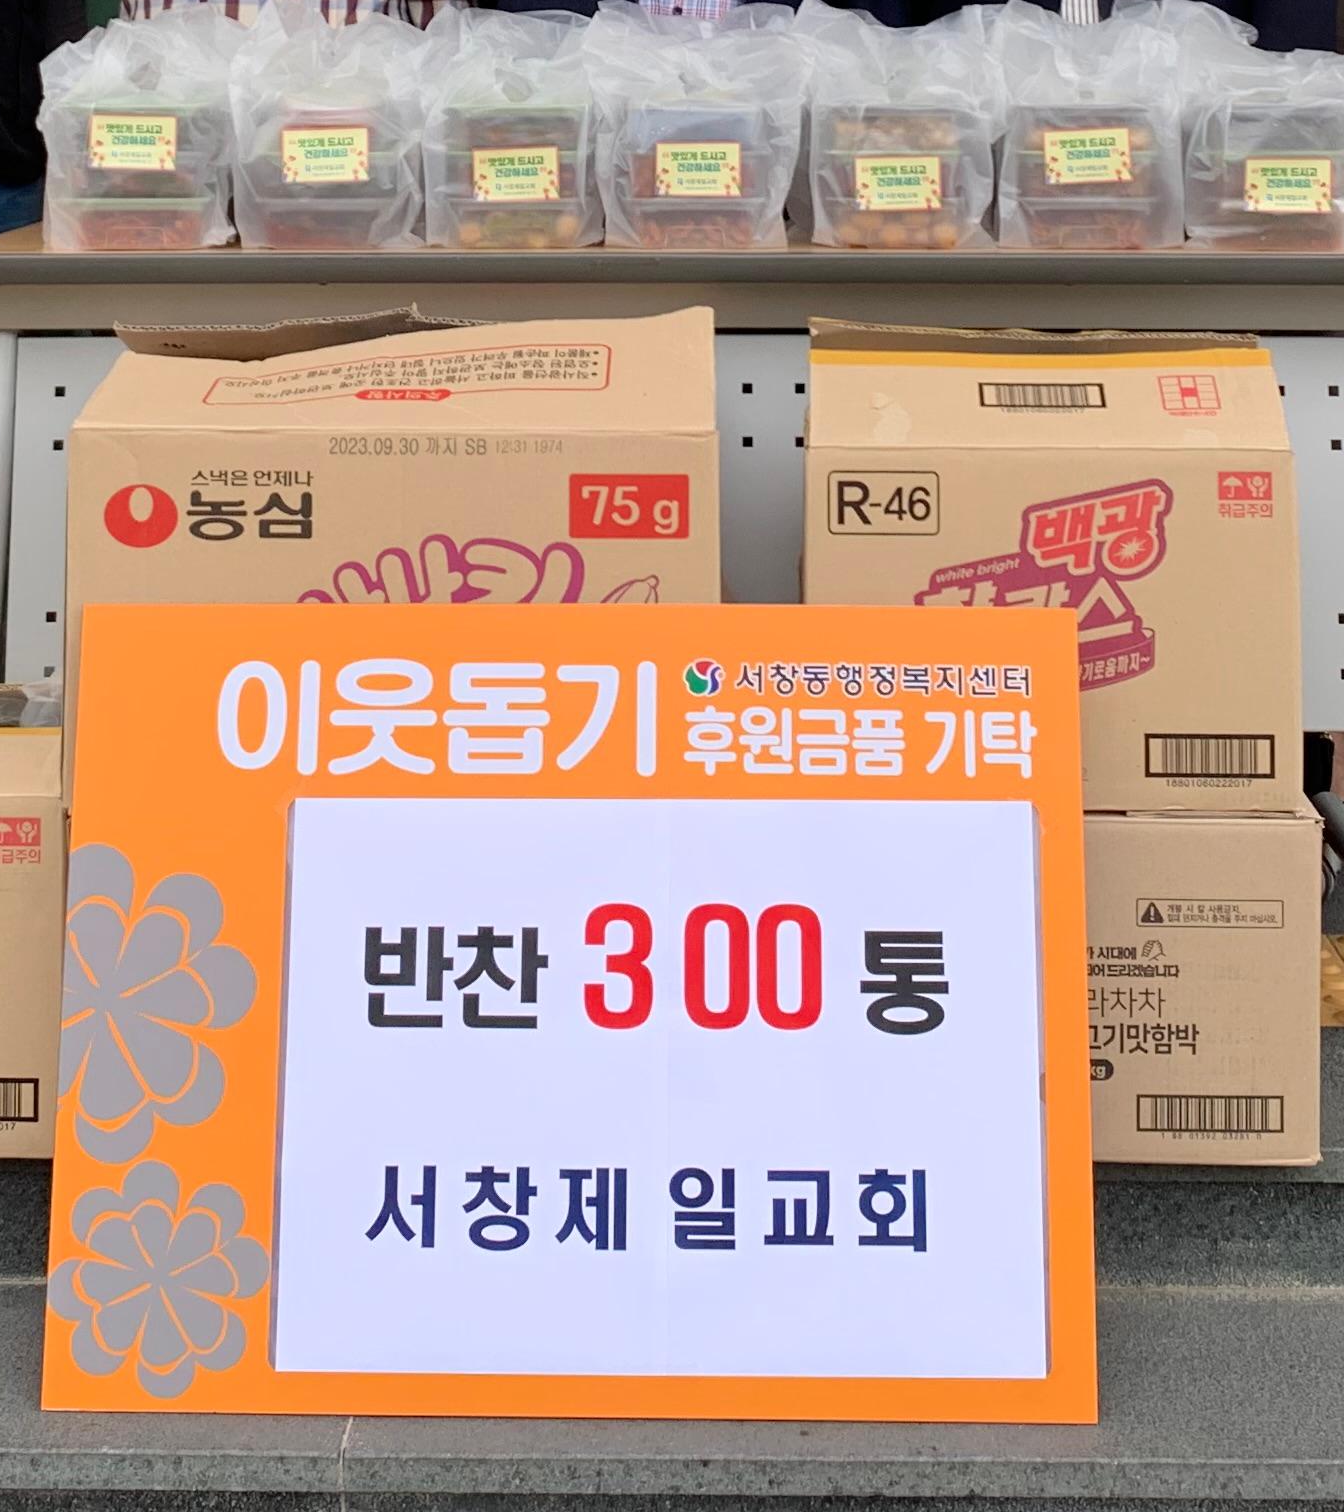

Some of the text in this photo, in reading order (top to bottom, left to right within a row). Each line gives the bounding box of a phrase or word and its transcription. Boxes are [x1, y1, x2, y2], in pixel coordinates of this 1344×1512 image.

[329, 437, 419, 455] 2023.09.30
[425, 437, 456, 456] 까지
[465, 438, 487, 455] SB
[534, 439, 562, 454] 1974
[190, 469, 314, 488] 스낵은 언제나
[186, 490, 314, 541] 농심
[581, 486, 680, 535] 75 g
[836, 481, 931, 525] R-46
[1218, 503, 1273, 518] 취급주의
[1033, 488, 1162, 571] 백광
[935, 558, 1020, 584] white bright
[734, 659, 1034, 699] 서창동행정복지센터
[215, 657, 656, 777] 이웃돕기
[684, 706, 1038, 779] 후원금품 기탁
[363, 903, 950, 1035] 반찬 300 통
[1097, 946, 1137, 960] 시대에
[363, 1165, 930, 1253] 서창제일교회
